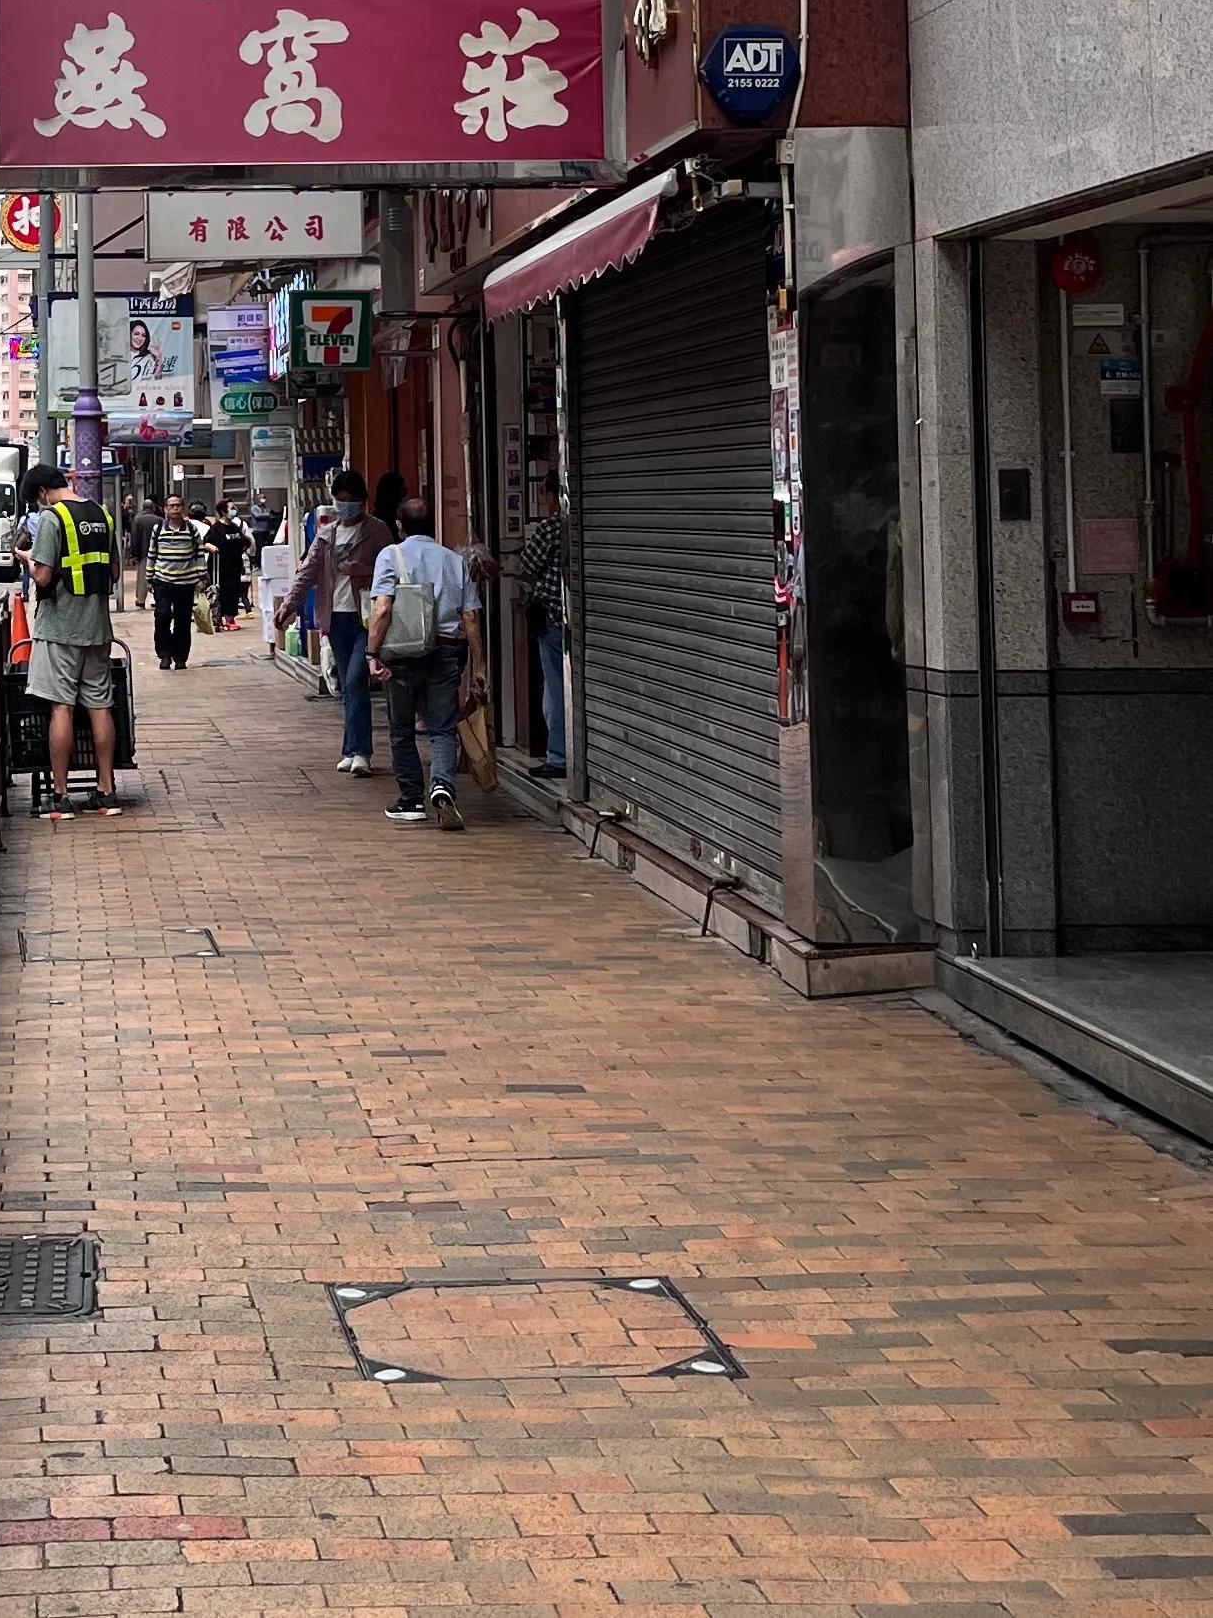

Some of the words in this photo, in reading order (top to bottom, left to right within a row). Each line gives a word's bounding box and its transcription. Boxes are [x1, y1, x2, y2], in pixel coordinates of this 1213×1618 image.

[724, 41, 783, 74] ADT
[33, 8, 569, 142] 燕窩莊
[727, 78, 753, 88] 2155
[754, 78, 780, 88] 0222
[189, 214, 324, 243] 有限公司
